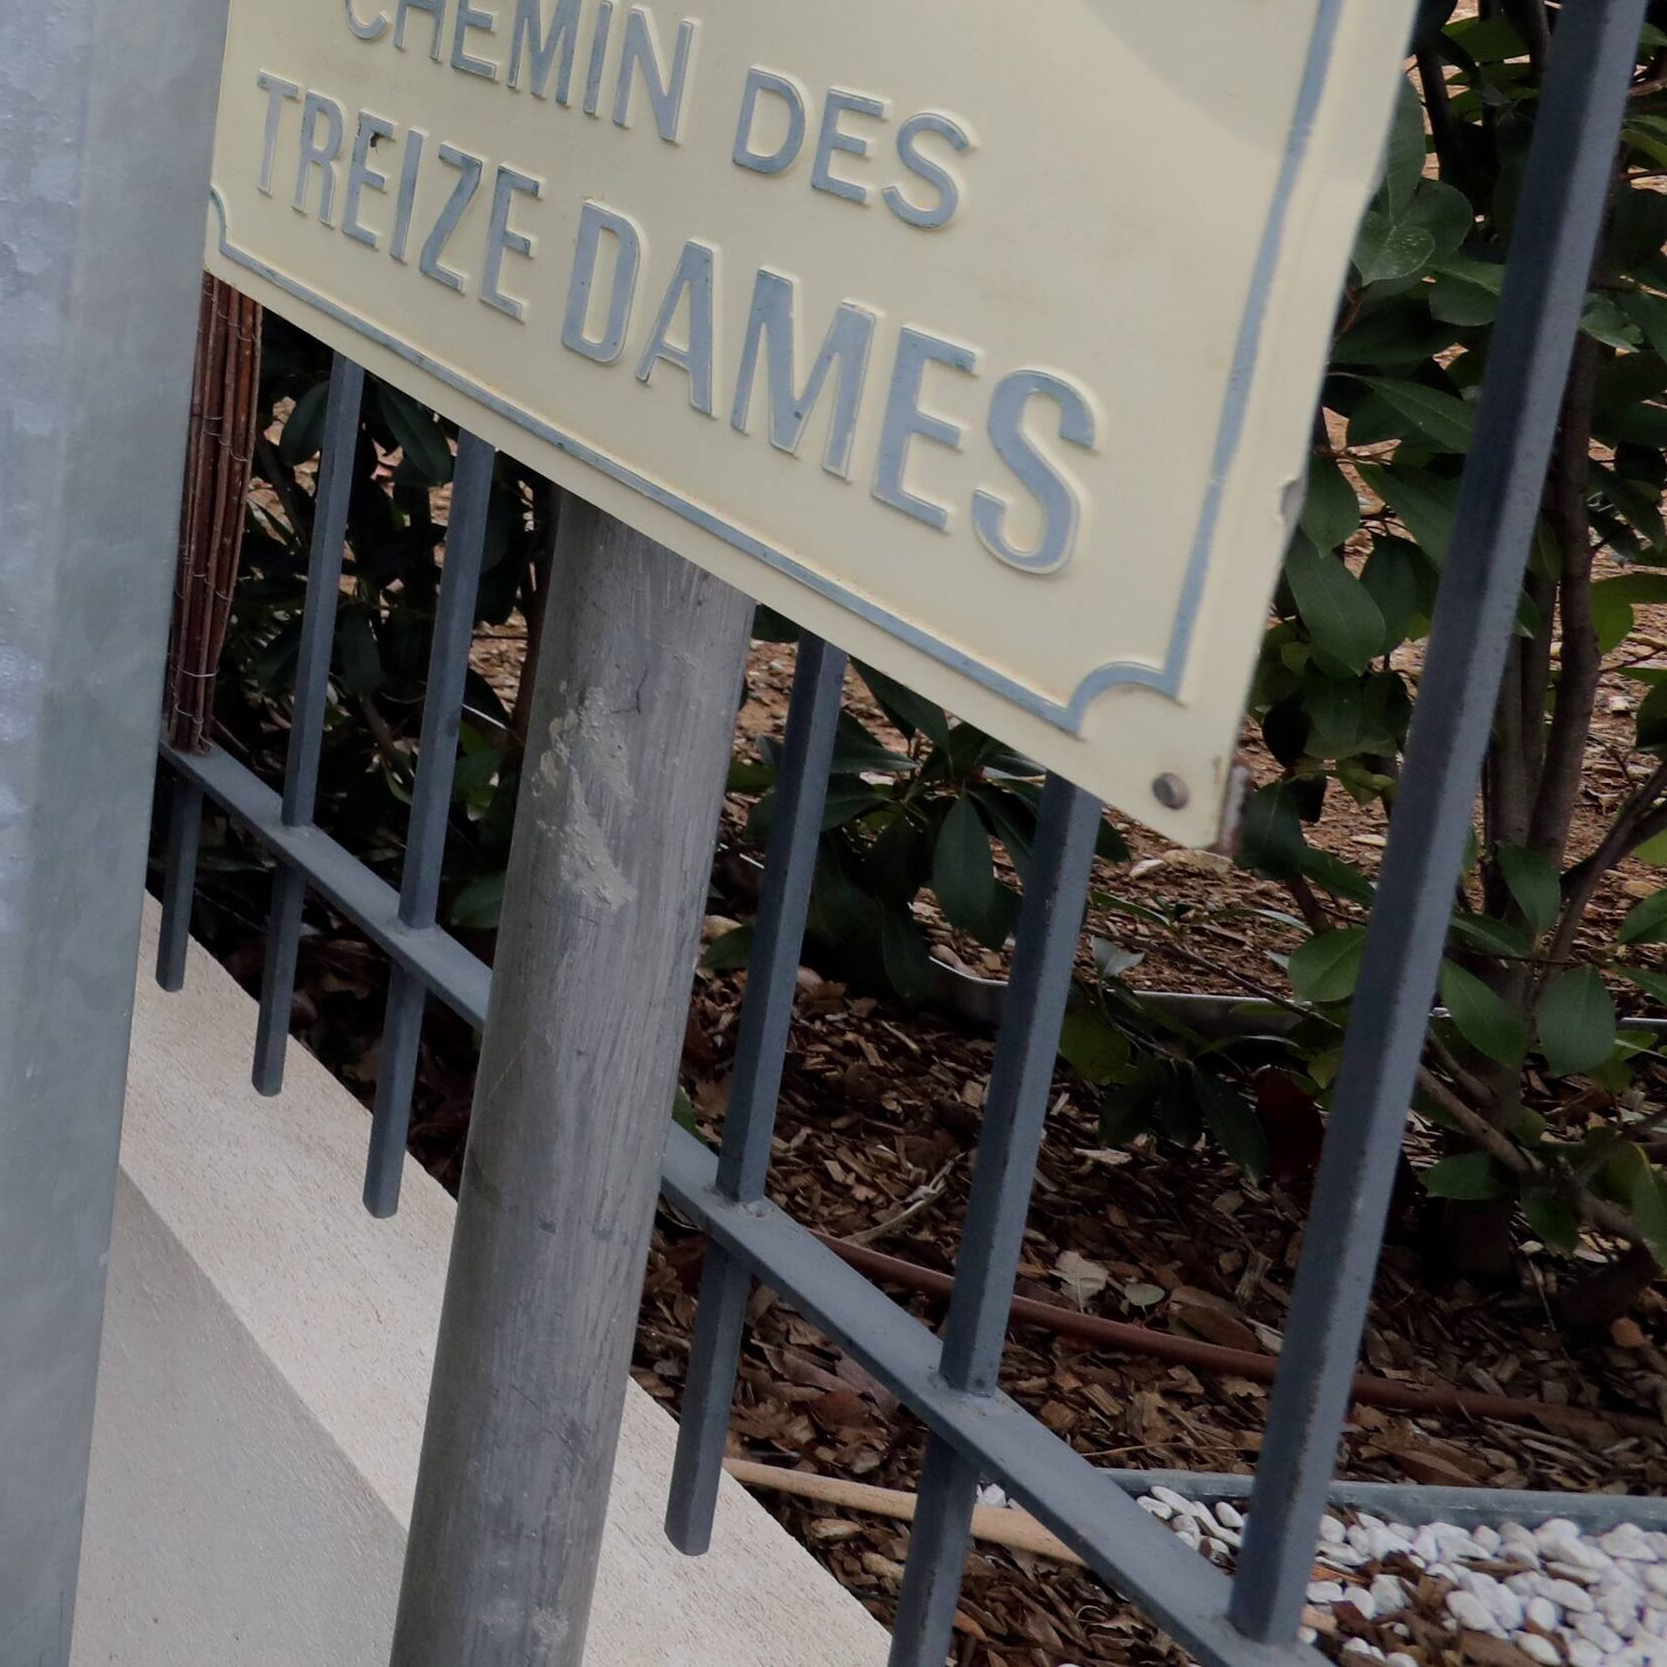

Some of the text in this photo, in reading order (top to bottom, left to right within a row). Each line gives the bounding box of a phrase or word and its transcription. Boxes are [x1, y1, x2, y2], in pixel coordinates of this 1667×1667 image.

[731, 64, 978, 231] DES
[257, 72, 1101, 575] TREIZE DAMES
